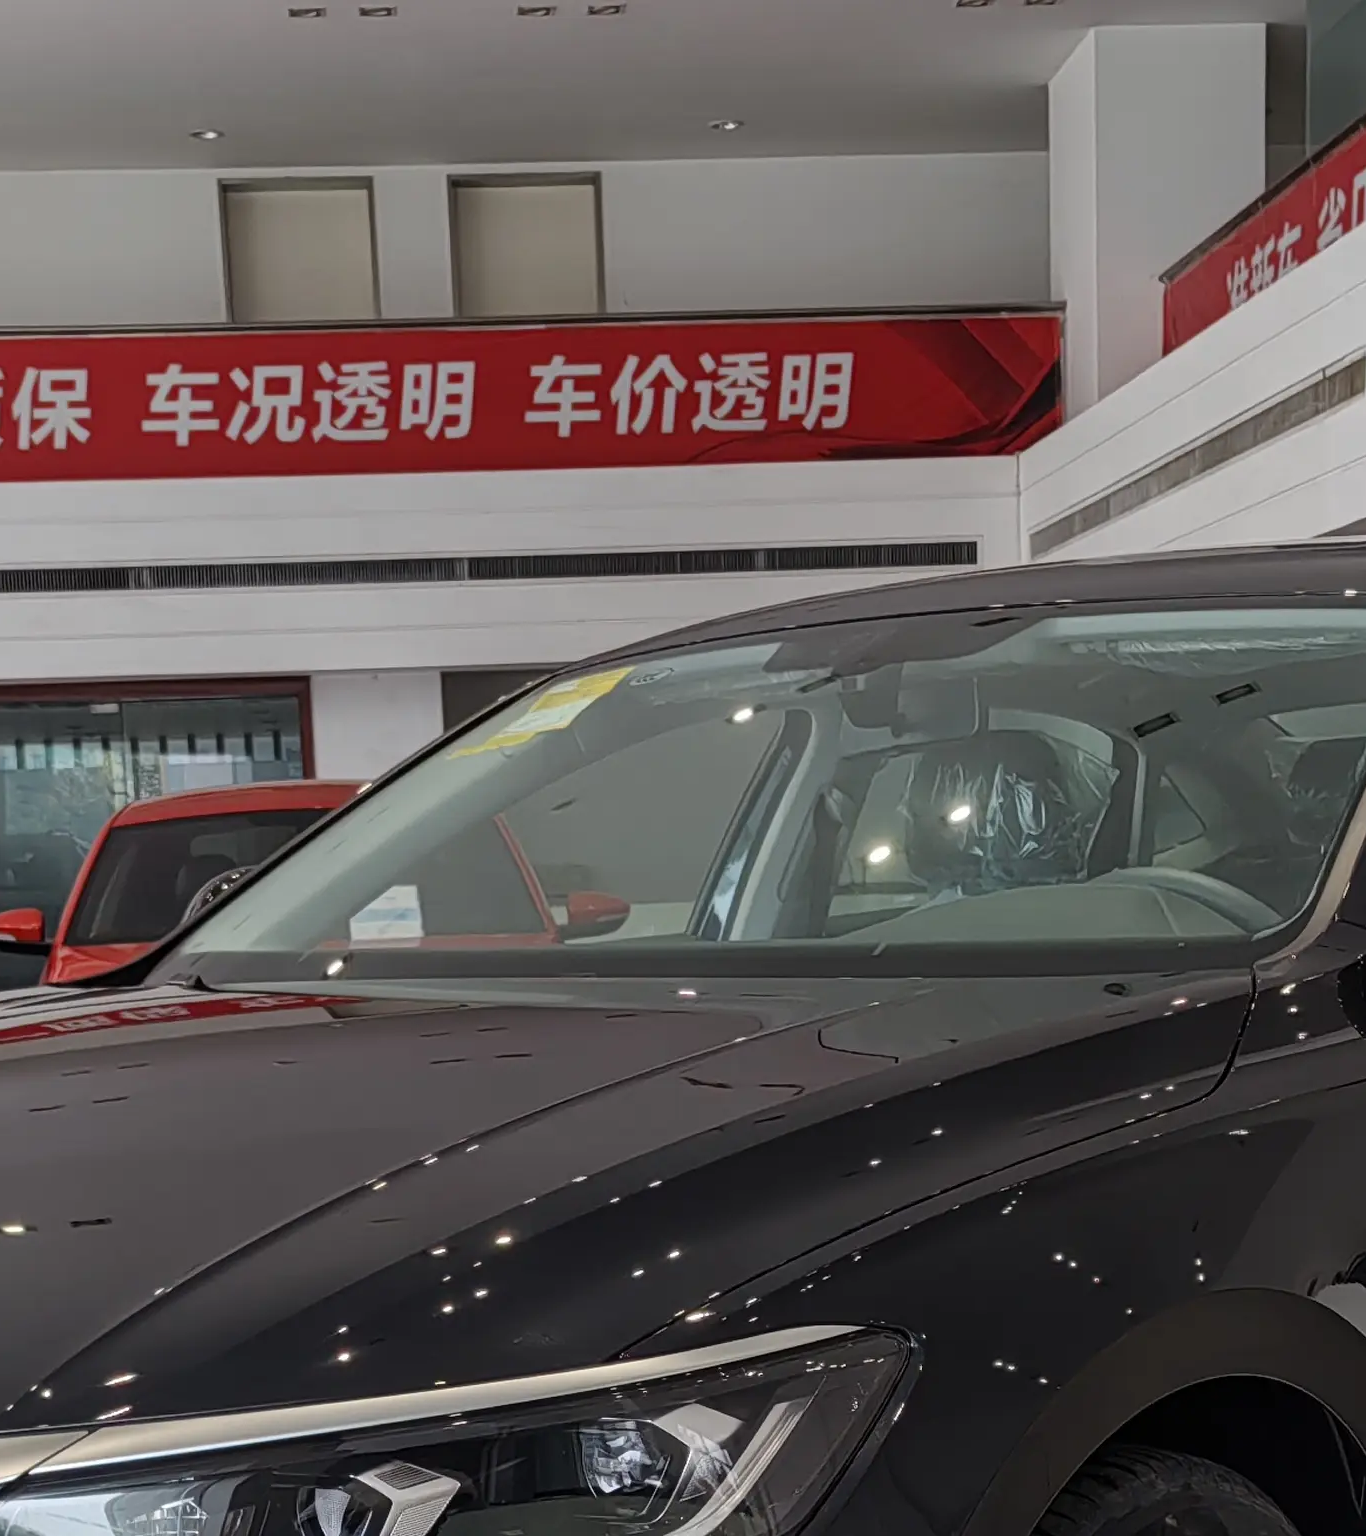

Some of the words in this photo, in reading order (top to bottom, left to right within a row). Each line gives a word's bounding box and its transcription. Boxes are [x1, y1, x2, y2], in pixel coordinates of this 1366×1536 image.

[141, 360, 476, 448] 车况透明
[523, 351, 855, 438] 车价透明
